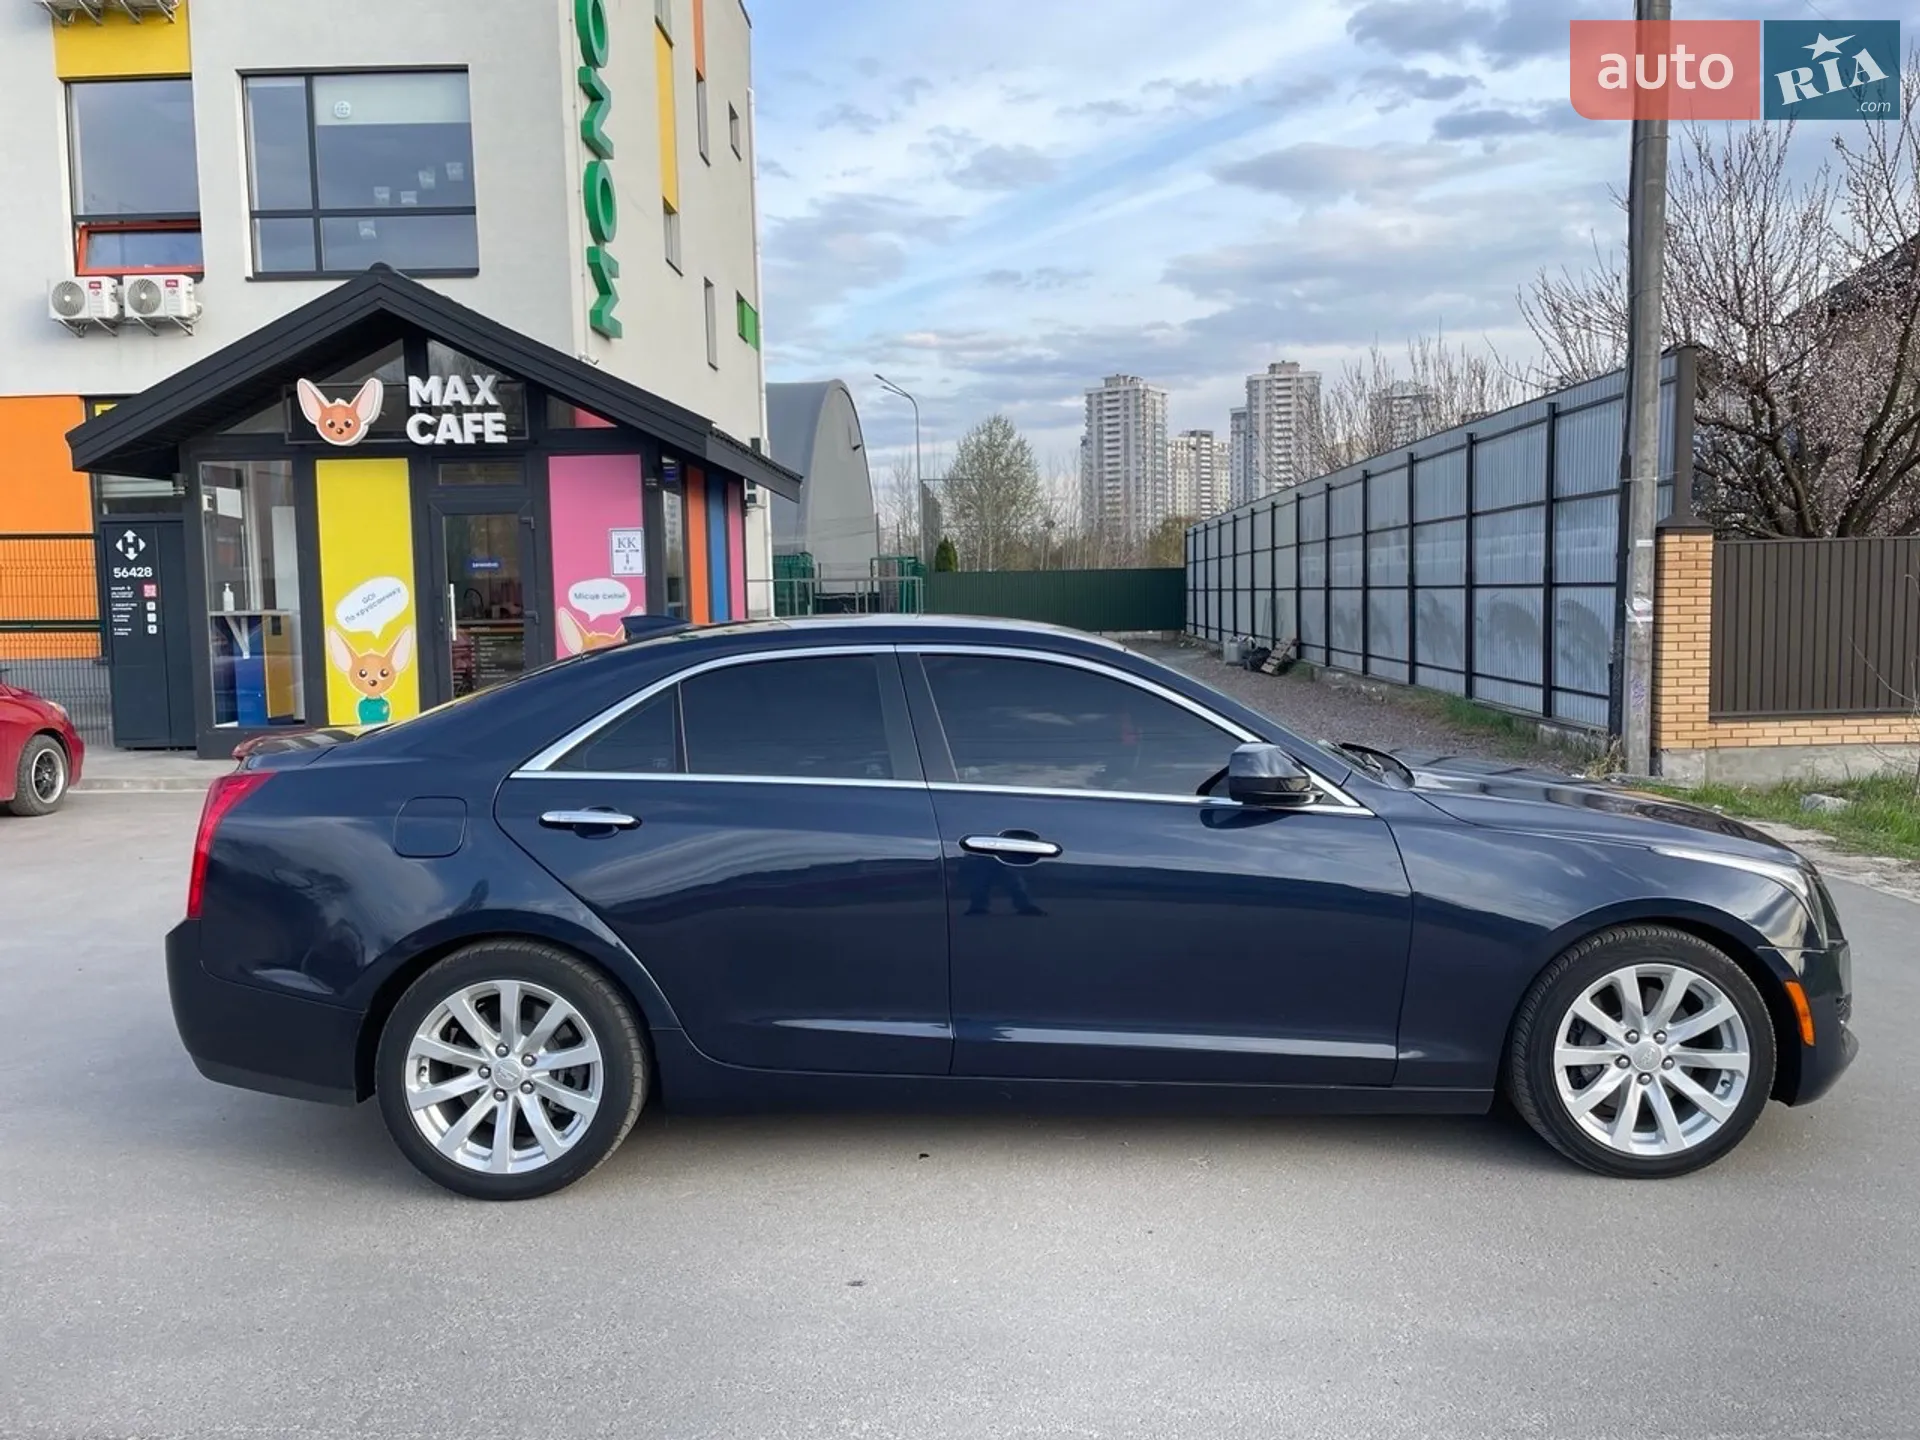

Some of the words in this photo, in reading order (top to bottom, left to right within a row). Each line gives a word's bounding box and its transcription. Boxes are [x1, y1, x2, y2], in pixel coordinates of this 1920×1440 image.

[408, 374, 500, 407] MAX
[406, 412, 508, 445] CAFE
[113, 566, 153, 578] 56428
